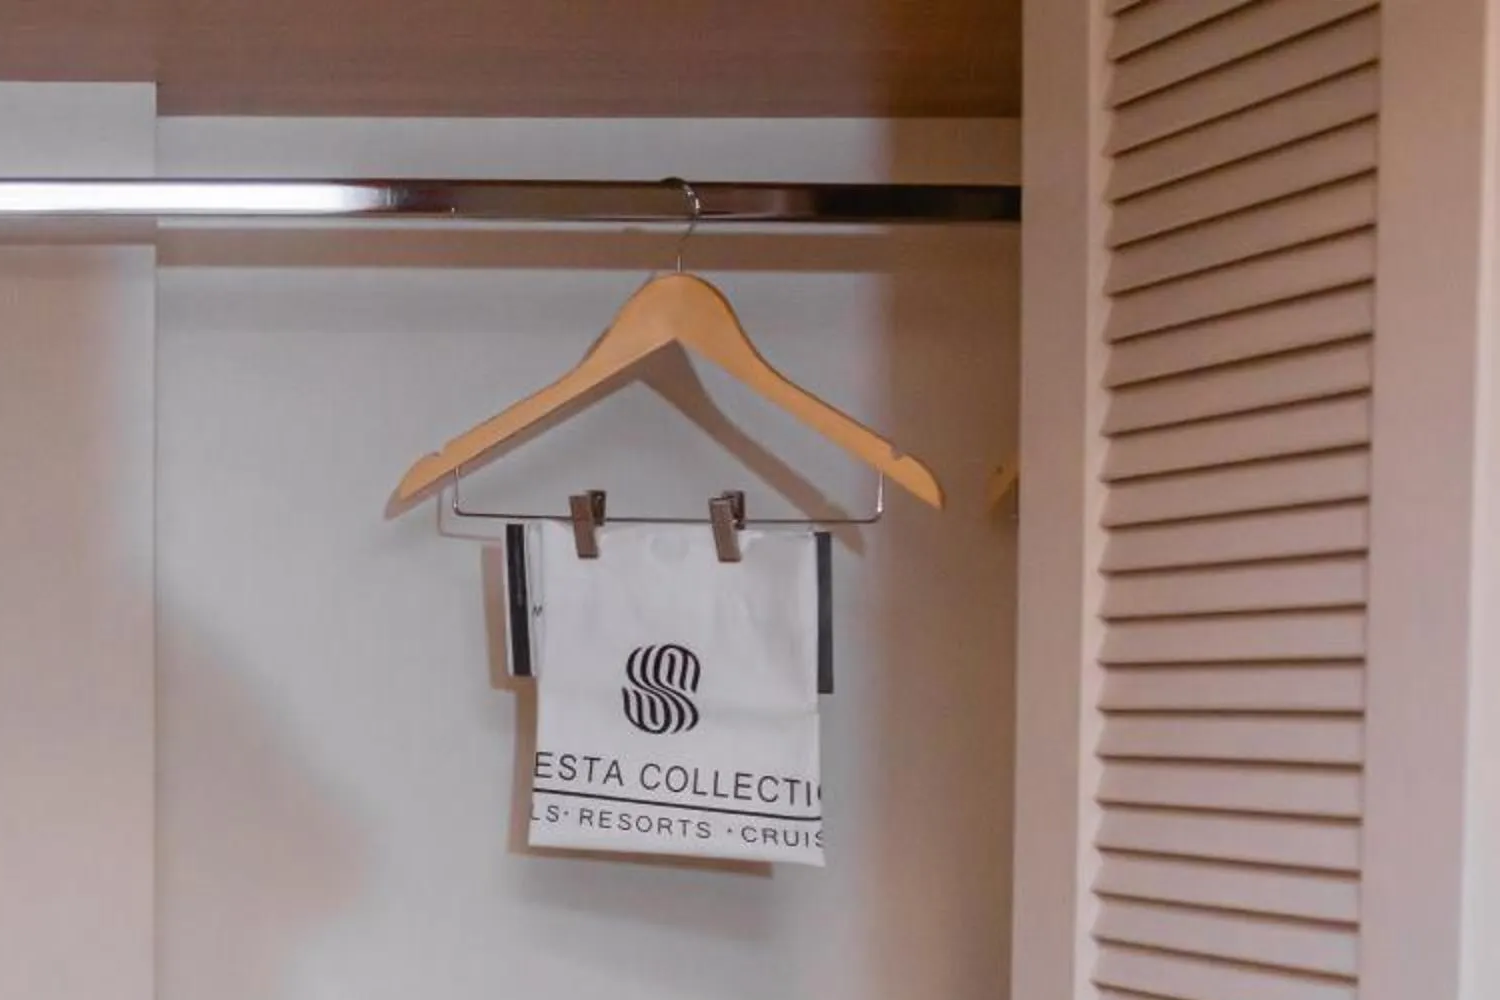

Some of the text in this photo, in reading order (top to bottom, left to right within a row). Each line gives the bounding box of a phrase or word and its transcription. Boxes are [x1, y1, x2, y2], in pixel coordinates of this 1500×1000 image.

[534, 751, 821, 807] ESTA COLLECTI
[578, 808, 711, 839] RESORTS
